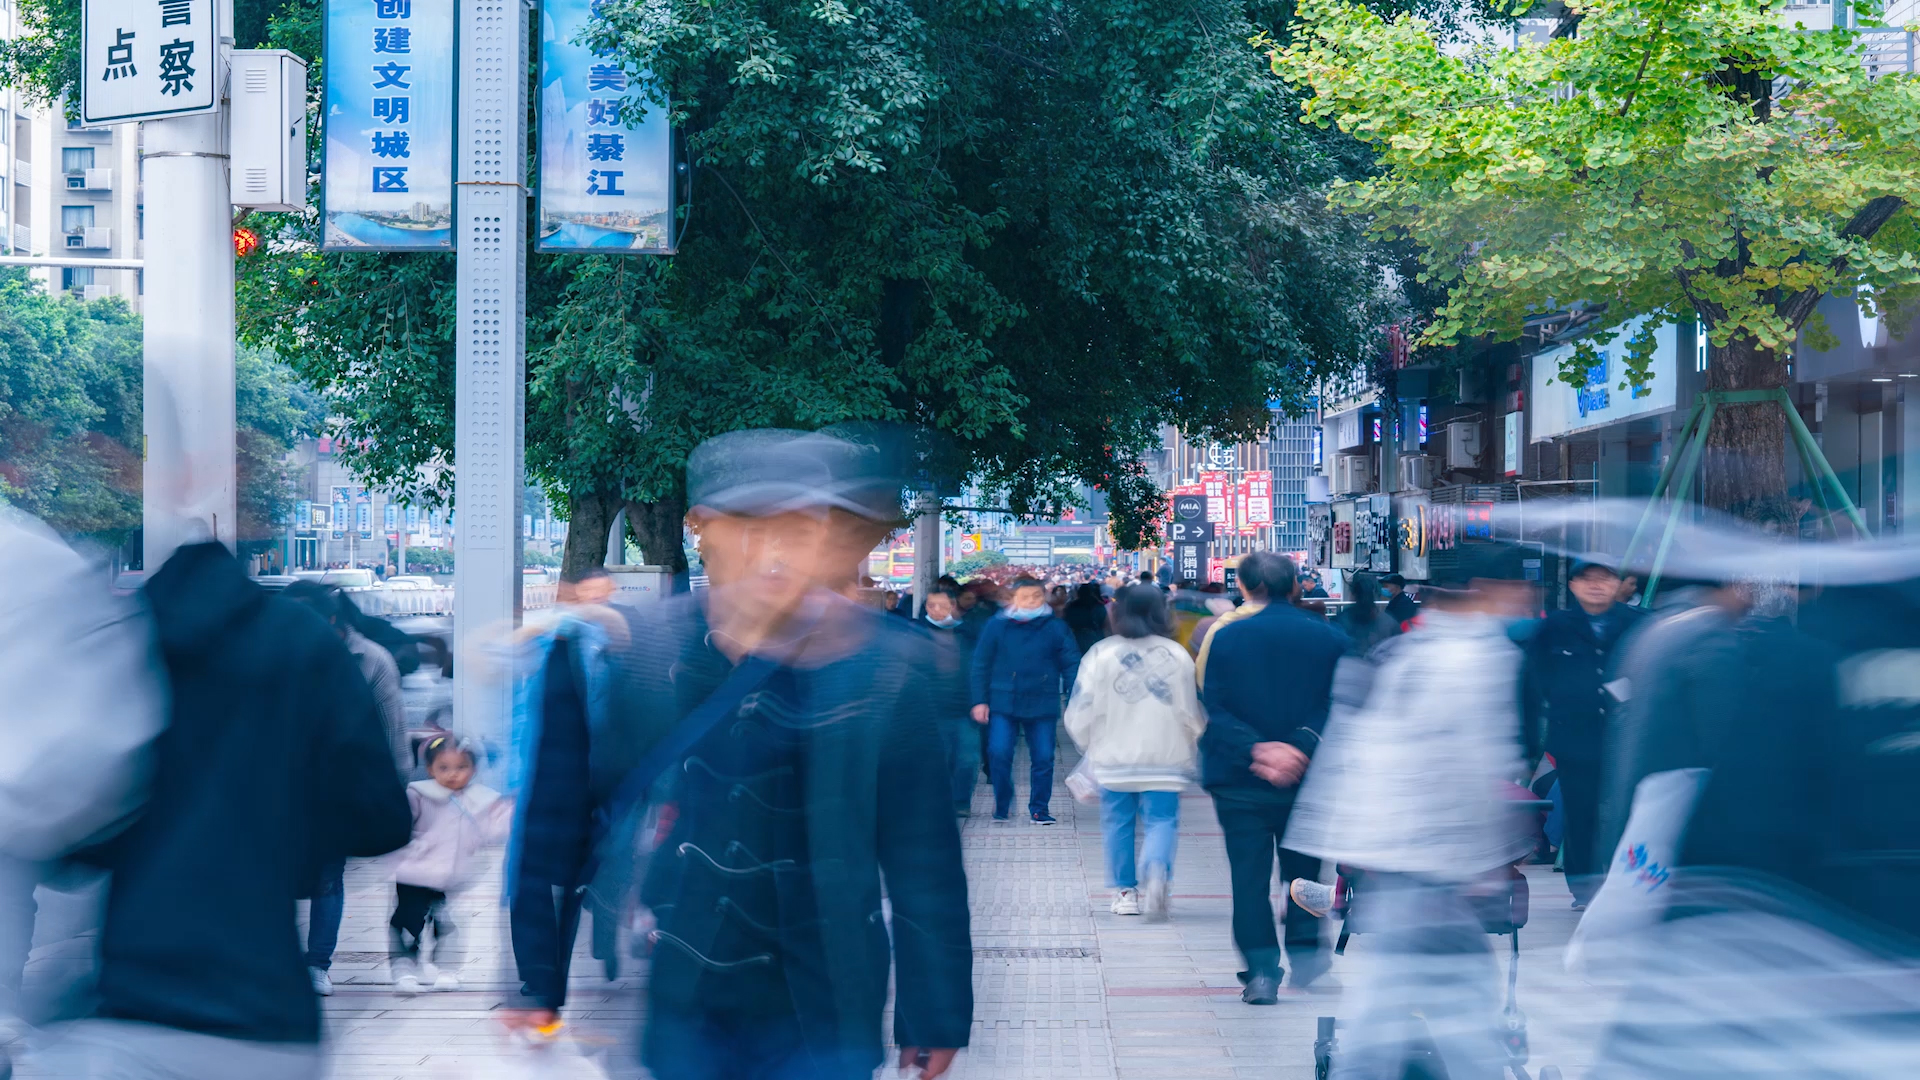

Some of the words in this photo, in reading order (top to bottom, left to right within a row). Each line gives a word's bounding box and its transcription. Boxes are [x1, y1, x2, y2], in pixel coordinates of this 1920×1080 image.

[372, 0, 411, 193] 创建文明城区
[586, 0, 626, 196] 美好綦江
[1172, 524, 1186, 540] P
[1183, 545, 1198, 586] 营销中
